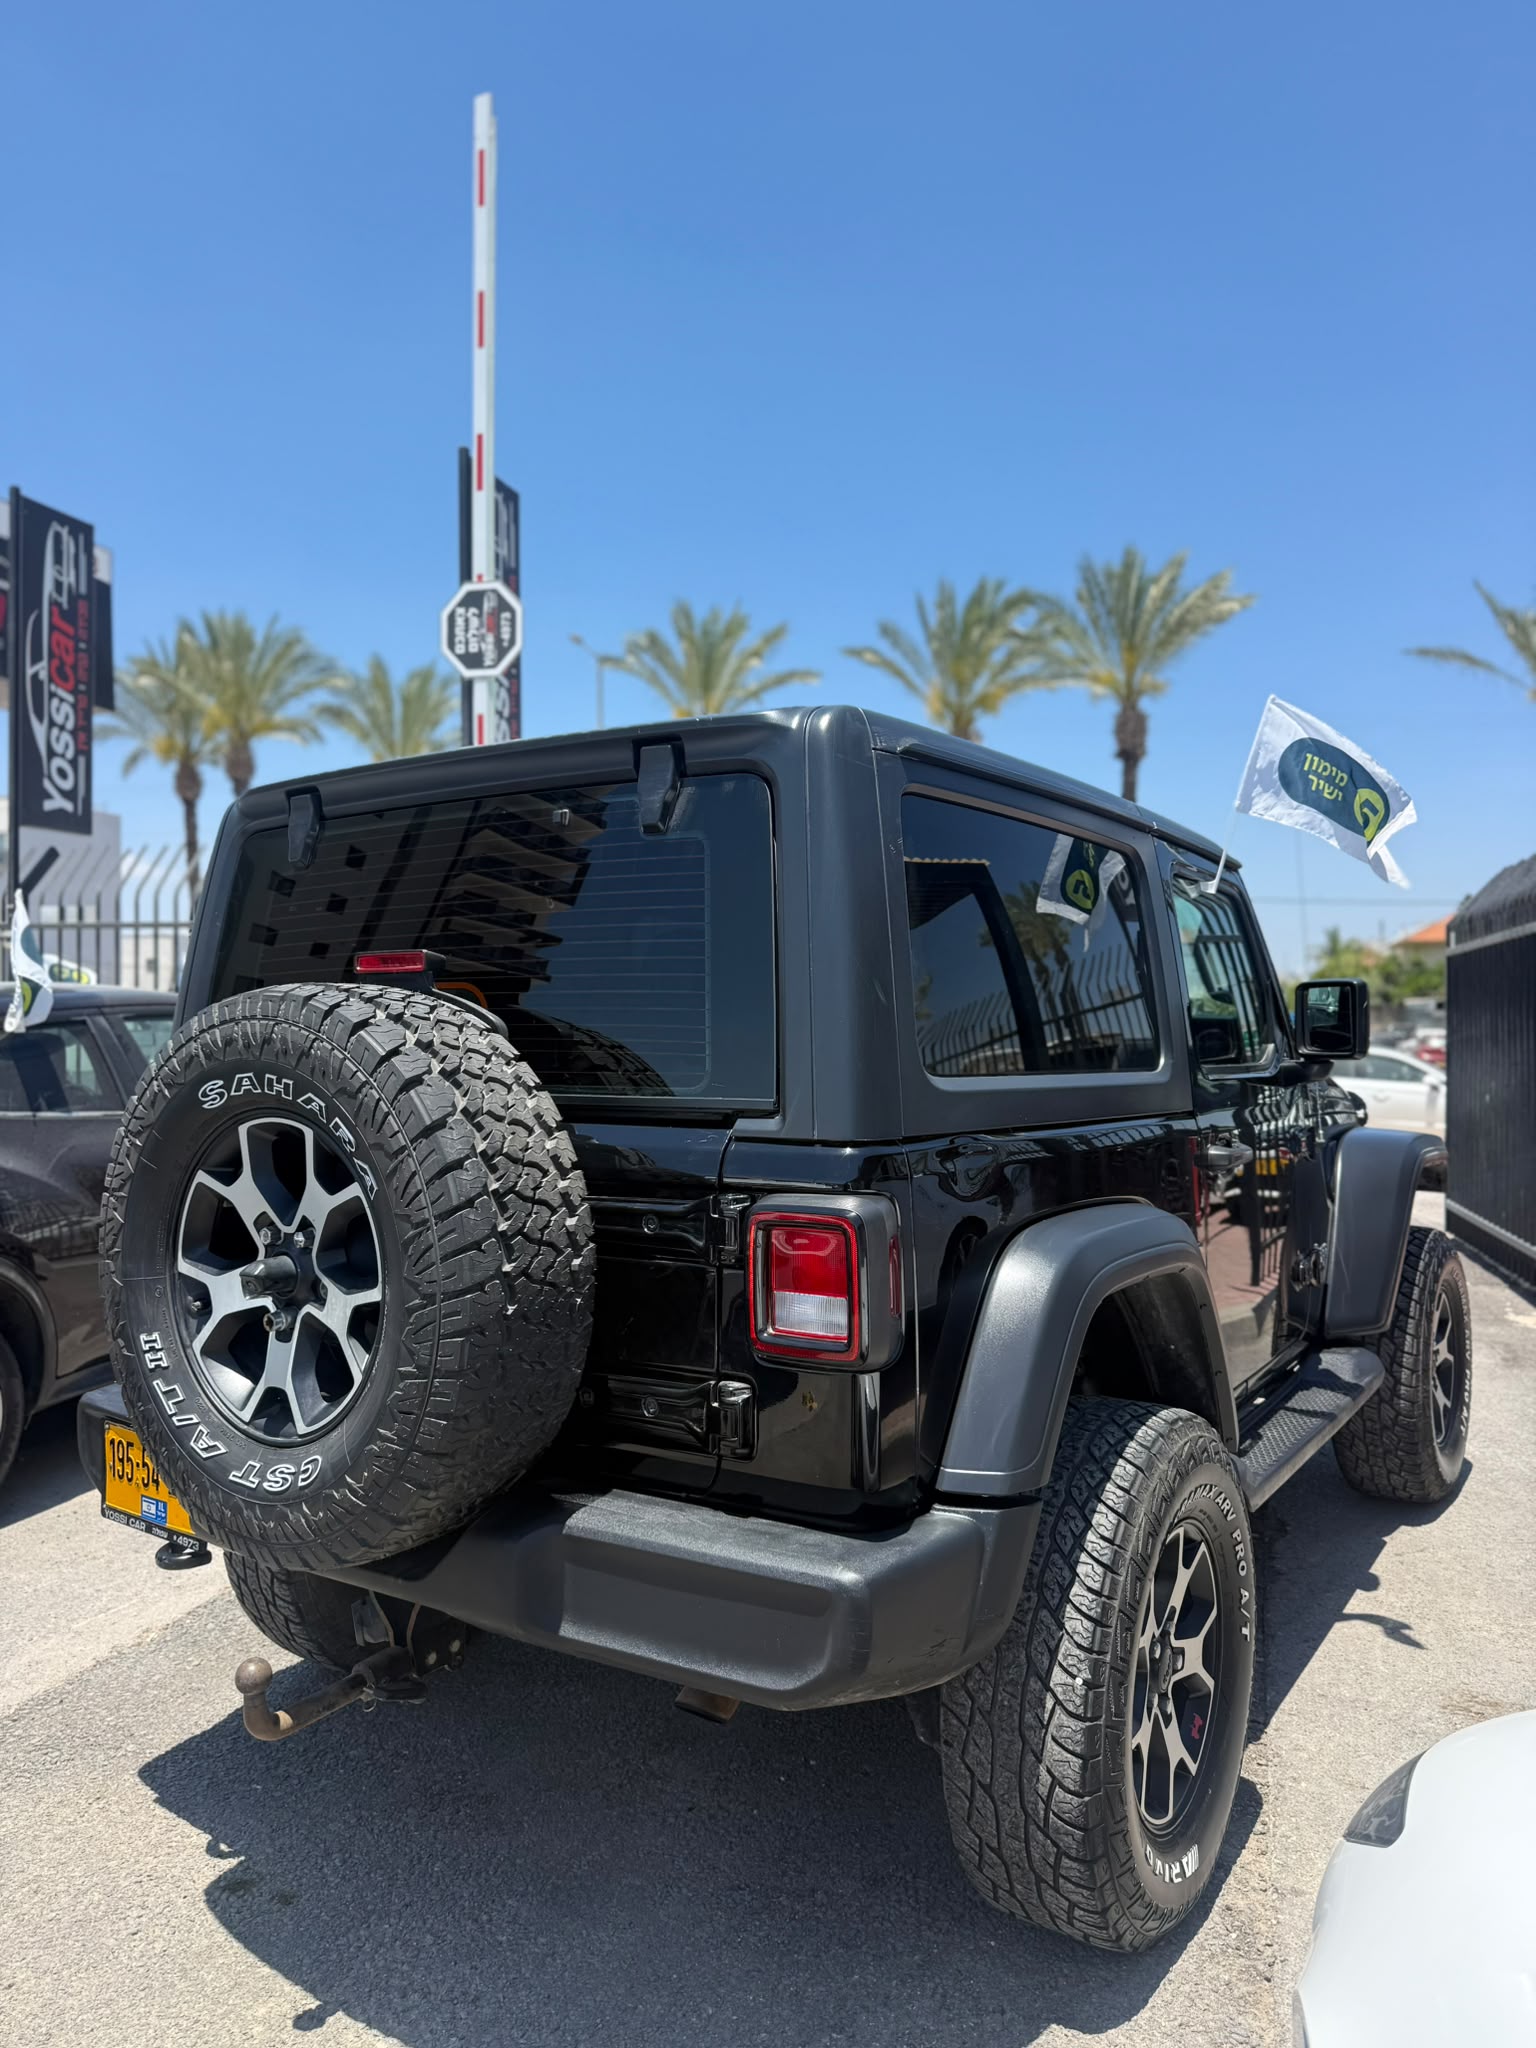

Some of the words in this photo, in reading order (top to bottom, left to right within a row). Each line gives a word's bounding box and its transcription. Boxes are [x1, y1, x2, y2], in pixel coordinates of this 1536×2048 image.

[1303, 753, 1348, 787] מימון
[1308, 774, 1343, 801] ישיר
[198, 1071, 376, 1201] SAHARA
[229, 1455, 323, 1494] CST
[104, 1508, 128, 1523] YOSSI
[129, 1518, 146, 1532] CAR
[1215, 1492, 1236, 1521] ARV
[1232, 1528, 1247, 1577] PRO
[1240, 1588, 1250, 1642] A/T
